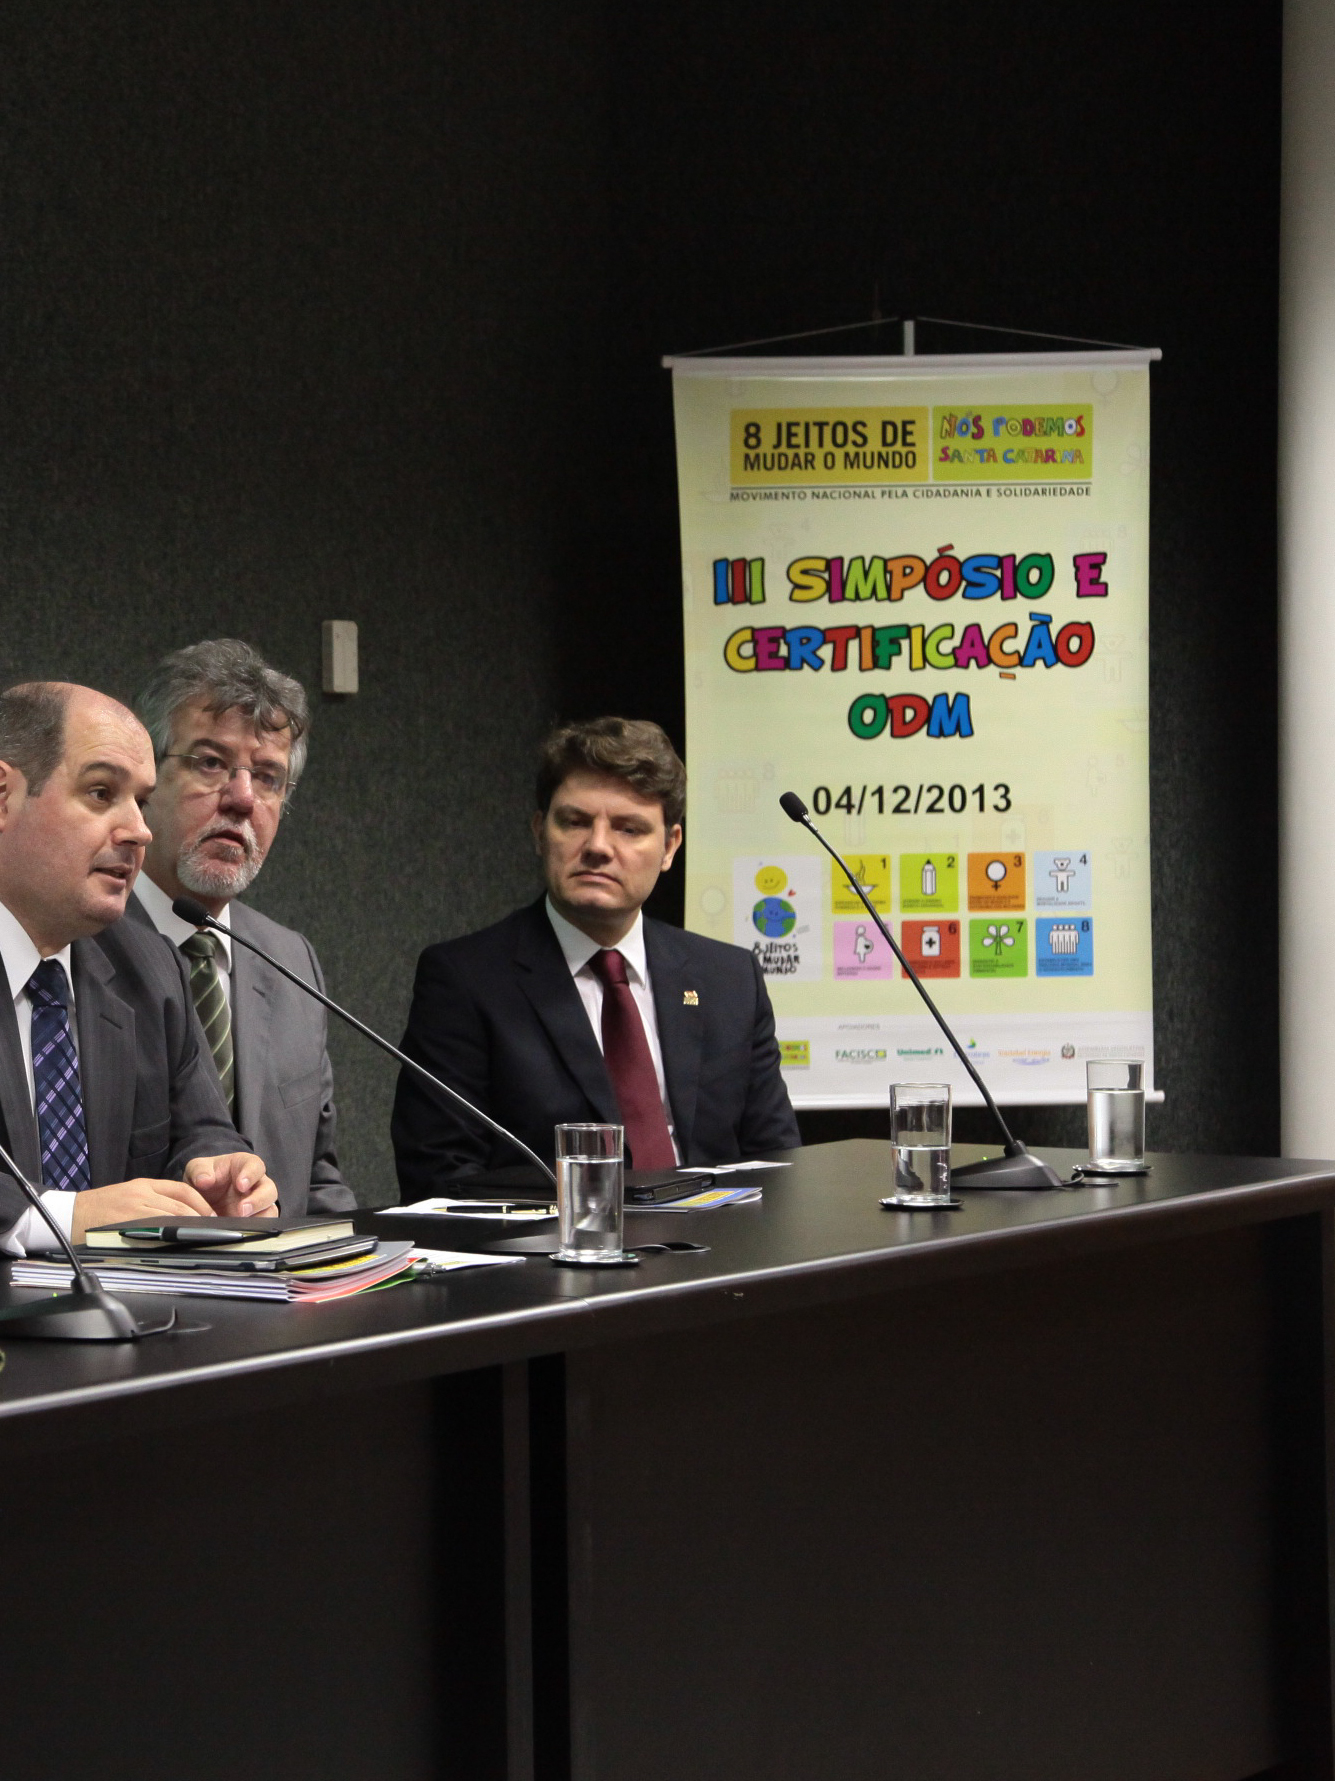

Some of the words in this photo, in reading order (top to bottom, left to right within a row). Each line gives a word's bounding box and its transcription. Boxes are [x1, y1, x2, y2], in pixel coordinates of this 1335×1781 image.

[743, 421, 761, 450] 8
[772, 420, 869, 450] JEITOS
[881, 419, 916, 449] DE
[992, 414, 1086, 438] PODEMOS
[743, 451, 816, 472] MUDAR
[823, 451, 836, 471] O
[843, 450, 917, 470] MUNDO
[938, 446, 998, 464] SANTA
[1002, 447, 1085, 464] CATARINA
[730, 489, 807, 503] MOVIMENTO
[811, 489, 876, 501] NACIONAL
[881, 488, 909, 500] PELA
[912, 487, 982, 499] CIDADANIA
[986, 487, 992, 498] E
[996, 485, 1091, 498] SOLIDARIEDADE
[712, 557, 766, 605] III
[786, 543, 1055, 603] SIMPÓSIO
[1073, 551, 1109, 599] E
[723, 611, 1096, 681] CERTIFICAÇÃO
[847, 692, 974, 740] ODM
[812, 783, 1013, 816] 04/12/2013
[880, 857, 887, 870] 1
[946, 855, 956, 869] 2
[1013, 854, 1023, 868] 3
[1079, 852, 1088, 866] 4
[948, 922, 957, 935] 6
[1016, 921, 1024, 934] 7
[1081, 920, 1090, 933] 8
[762, 954, 800, 967] MUDAR
